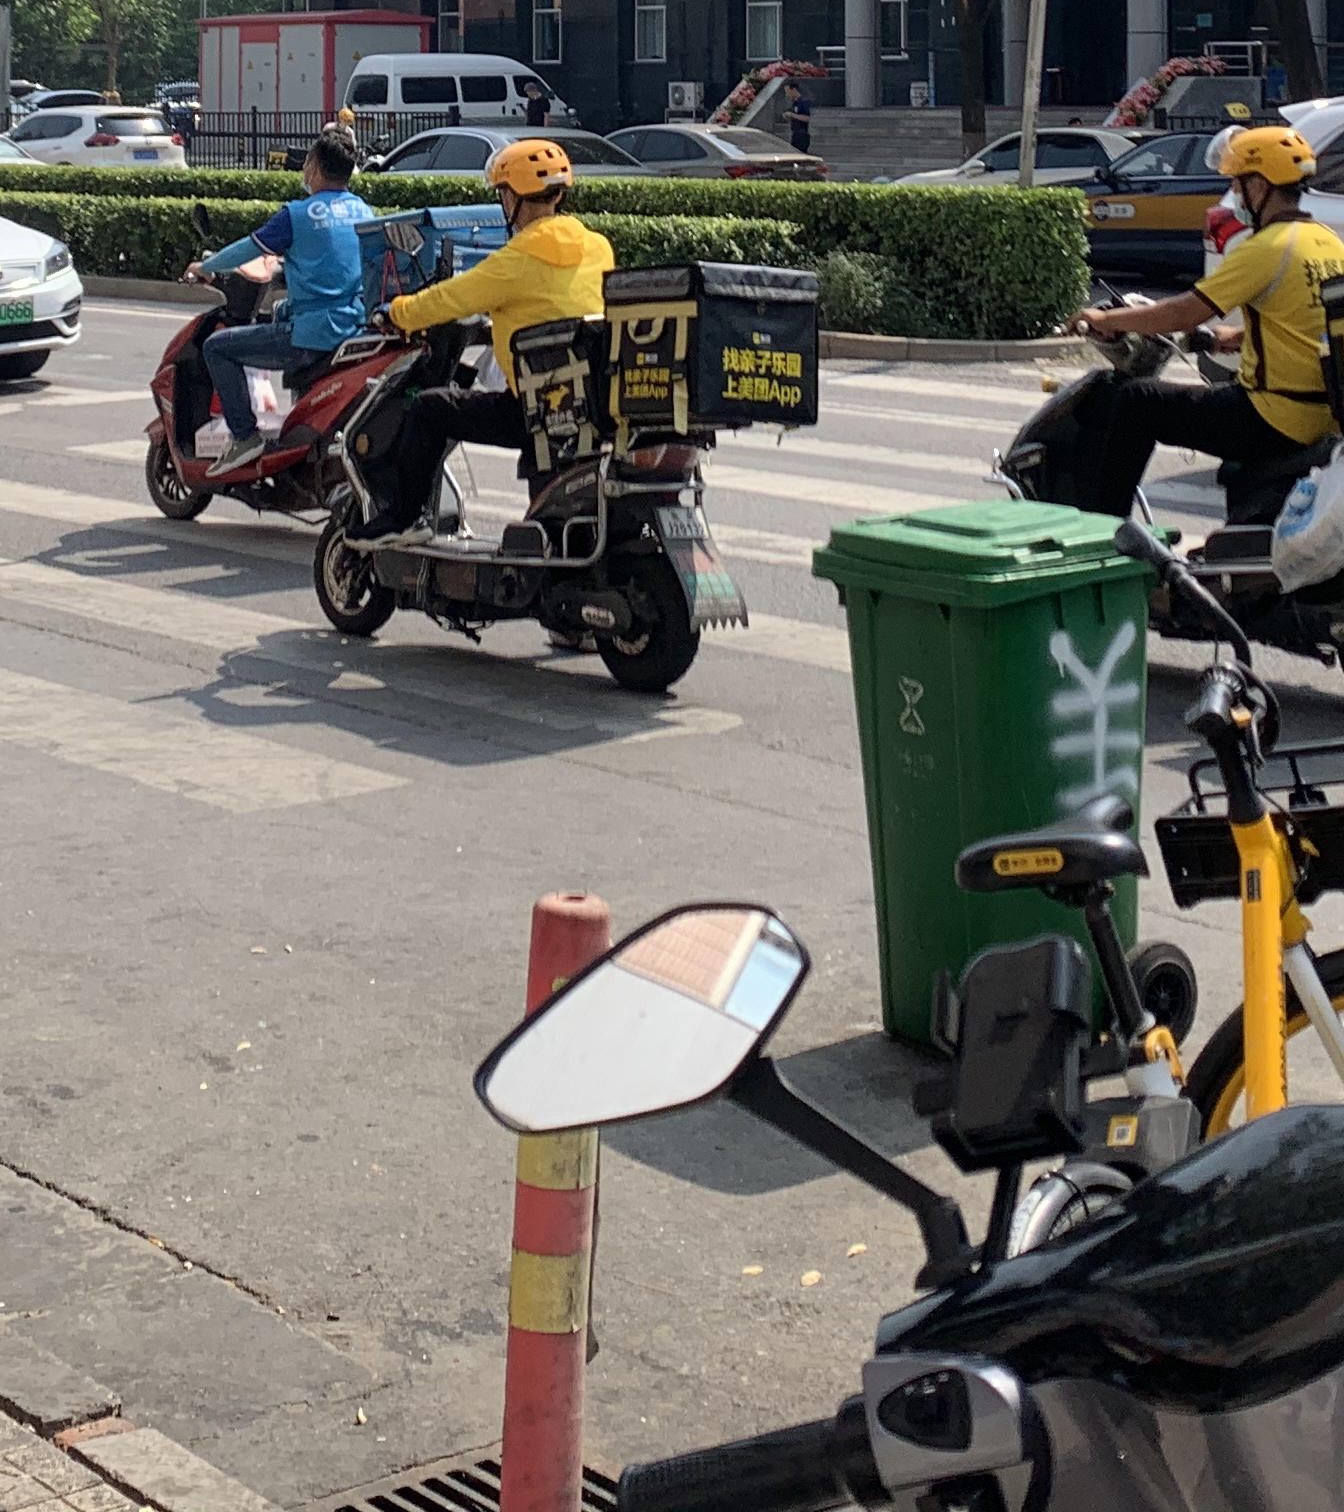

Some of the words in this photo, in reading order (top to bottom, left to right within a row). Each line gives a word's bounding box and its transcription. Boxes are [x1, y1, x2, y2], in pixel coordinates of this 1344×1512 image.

[722, 346, 802, 378] 找亲子乐园
[722, 374, 802, 407] 上美团App
